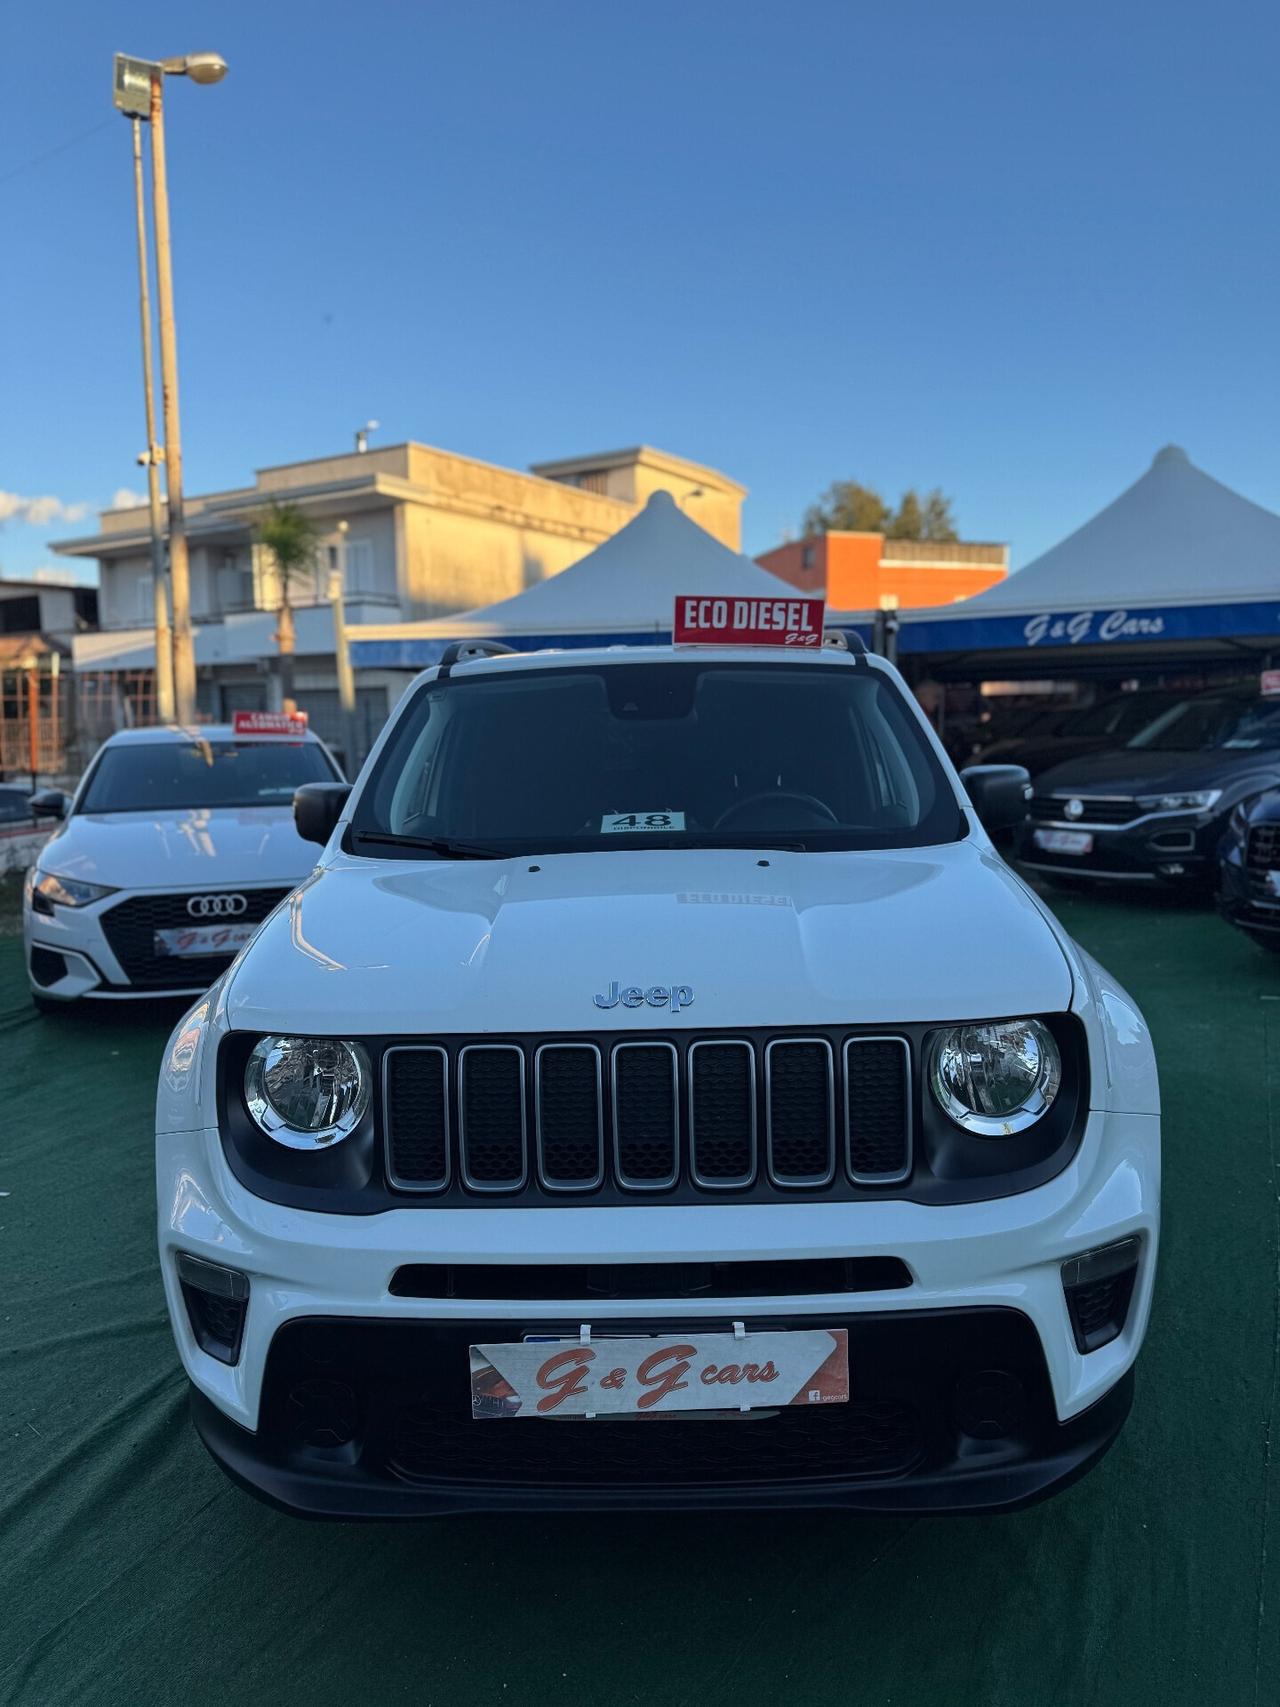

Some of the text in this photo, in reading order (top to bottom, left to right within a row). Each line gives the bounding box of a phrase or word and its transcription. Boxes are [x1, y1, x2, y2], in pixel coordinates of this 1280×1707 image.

[684, 600, 813, 631] ECO DIESEL
[1099, 610, 1164, 641] Cars
[612, 814, 671, 826] 48
[593, 980, 695, 1013] Jeep
[699, 1360, 781, 1385] cars
